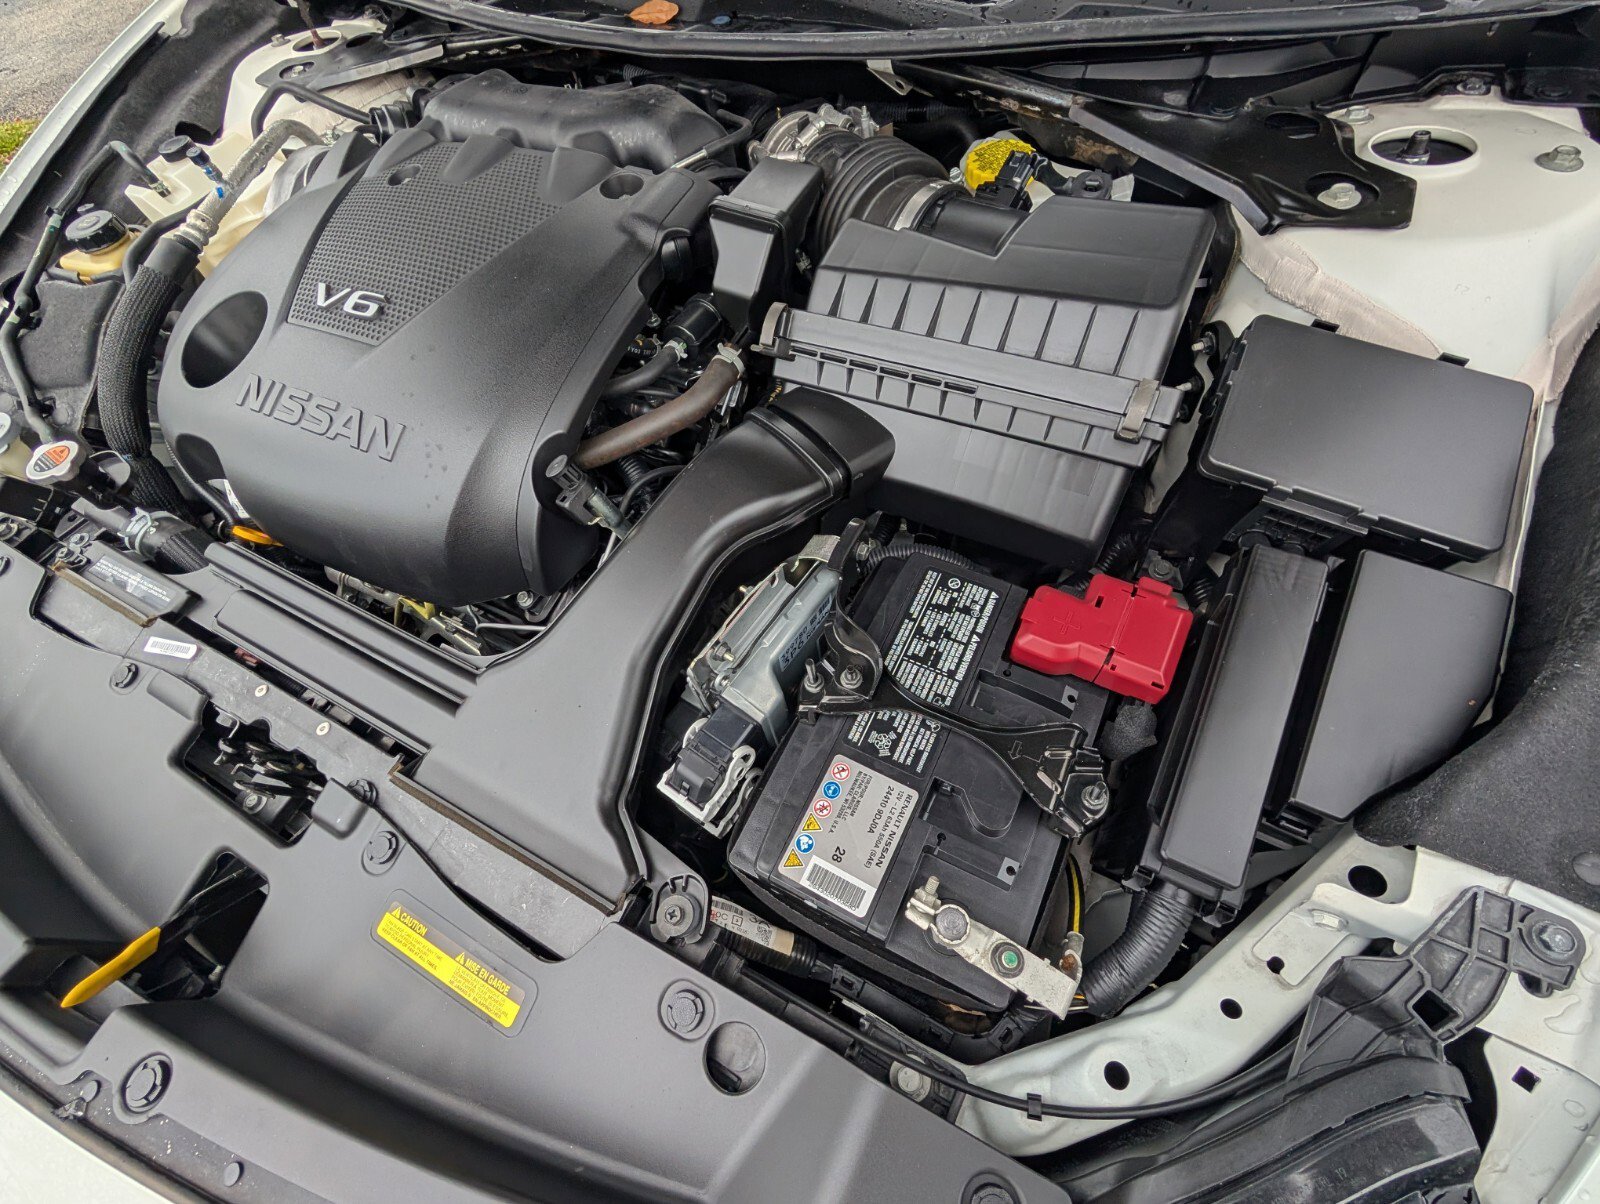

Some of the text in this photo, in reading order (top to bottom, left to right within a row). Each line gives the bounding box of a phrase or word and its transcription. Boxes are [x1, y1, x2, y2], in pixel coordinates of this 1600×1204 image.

[317, 282, 387, 319] V6
[235, 373, 407, 462] NISSAN
[842, 797, 849, 805] WI
[879, 785, 894, 808] 24410
[894, 789, 904, 801] 12V
[840, 810, 848, 821] LLC
[848, 799, 860, 817] NISSAN
[888, 805, 896, 815] L2
[874, 793, 912, 868] RENAULT NISSAN
[880, 814, 892, 832] 63Ah
[872, 831, 885, 849] 550A
[830, 845, 846, 864] 28
[863, 848, 877, 869] (SAE)
[399, 911, 427, 937] CAUTION
[464, 957, 480, 976] MISE
[478, 967, 489, 982] EN
[487, 973, 510, 996] GARDE
